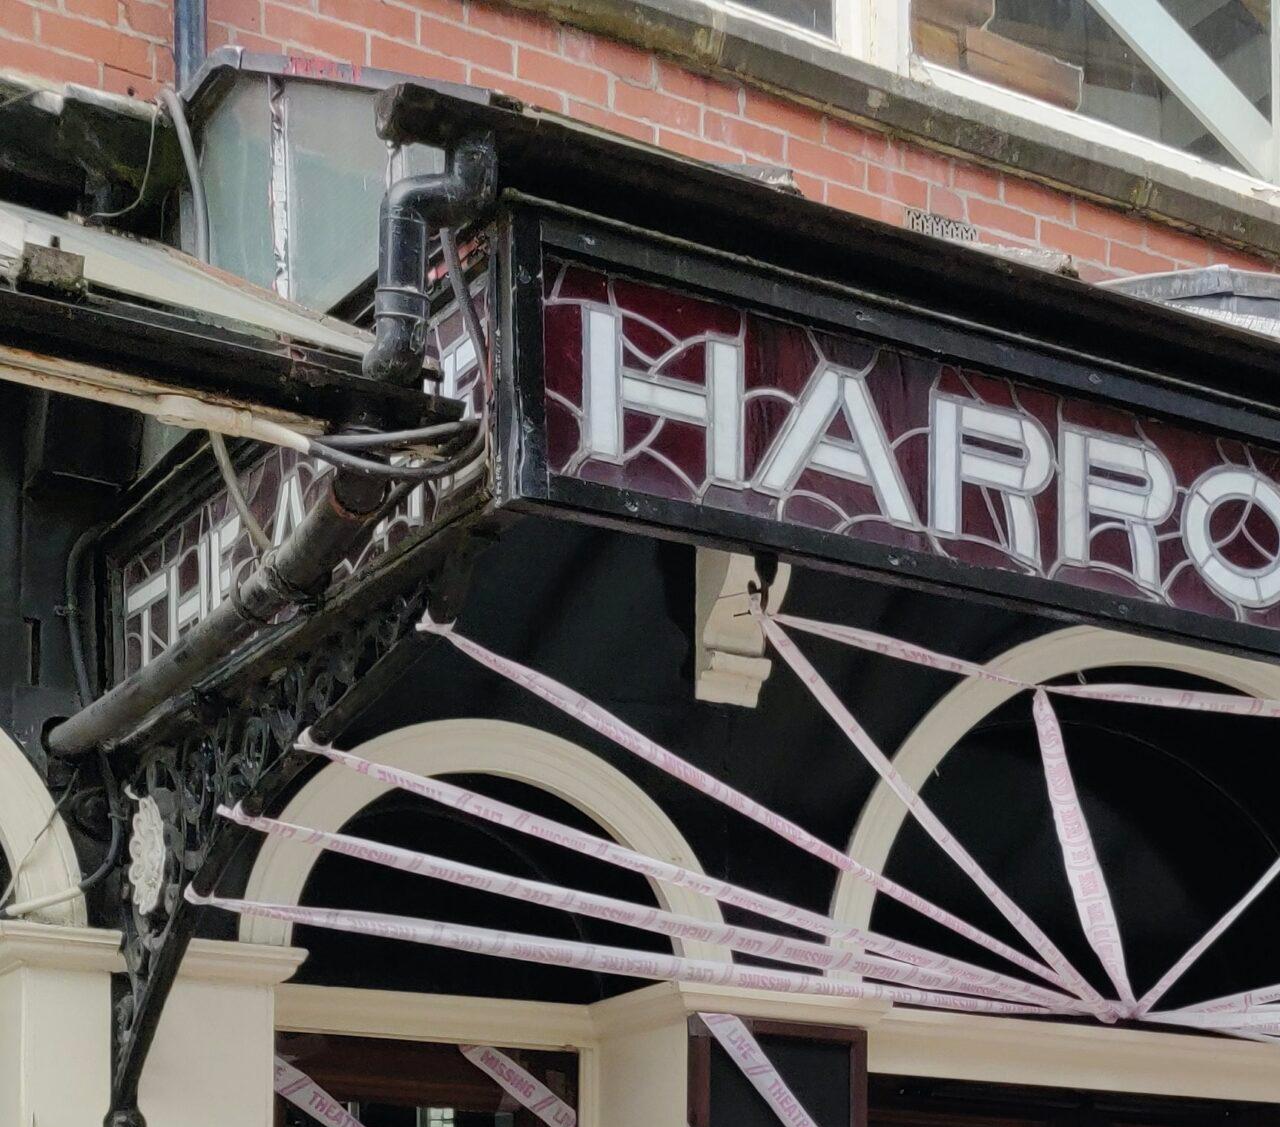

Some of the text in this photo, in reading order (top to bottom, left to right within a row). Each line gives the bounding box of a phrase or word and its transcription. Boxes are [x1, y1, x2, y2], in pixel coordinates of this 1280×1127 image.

[738, 936, 764, 951] LIVE
[598, 953, 660, 976] THEATRE
[737, 973, 791, 993] MISSING
[479, 1047, 537, 1099] MISSING
